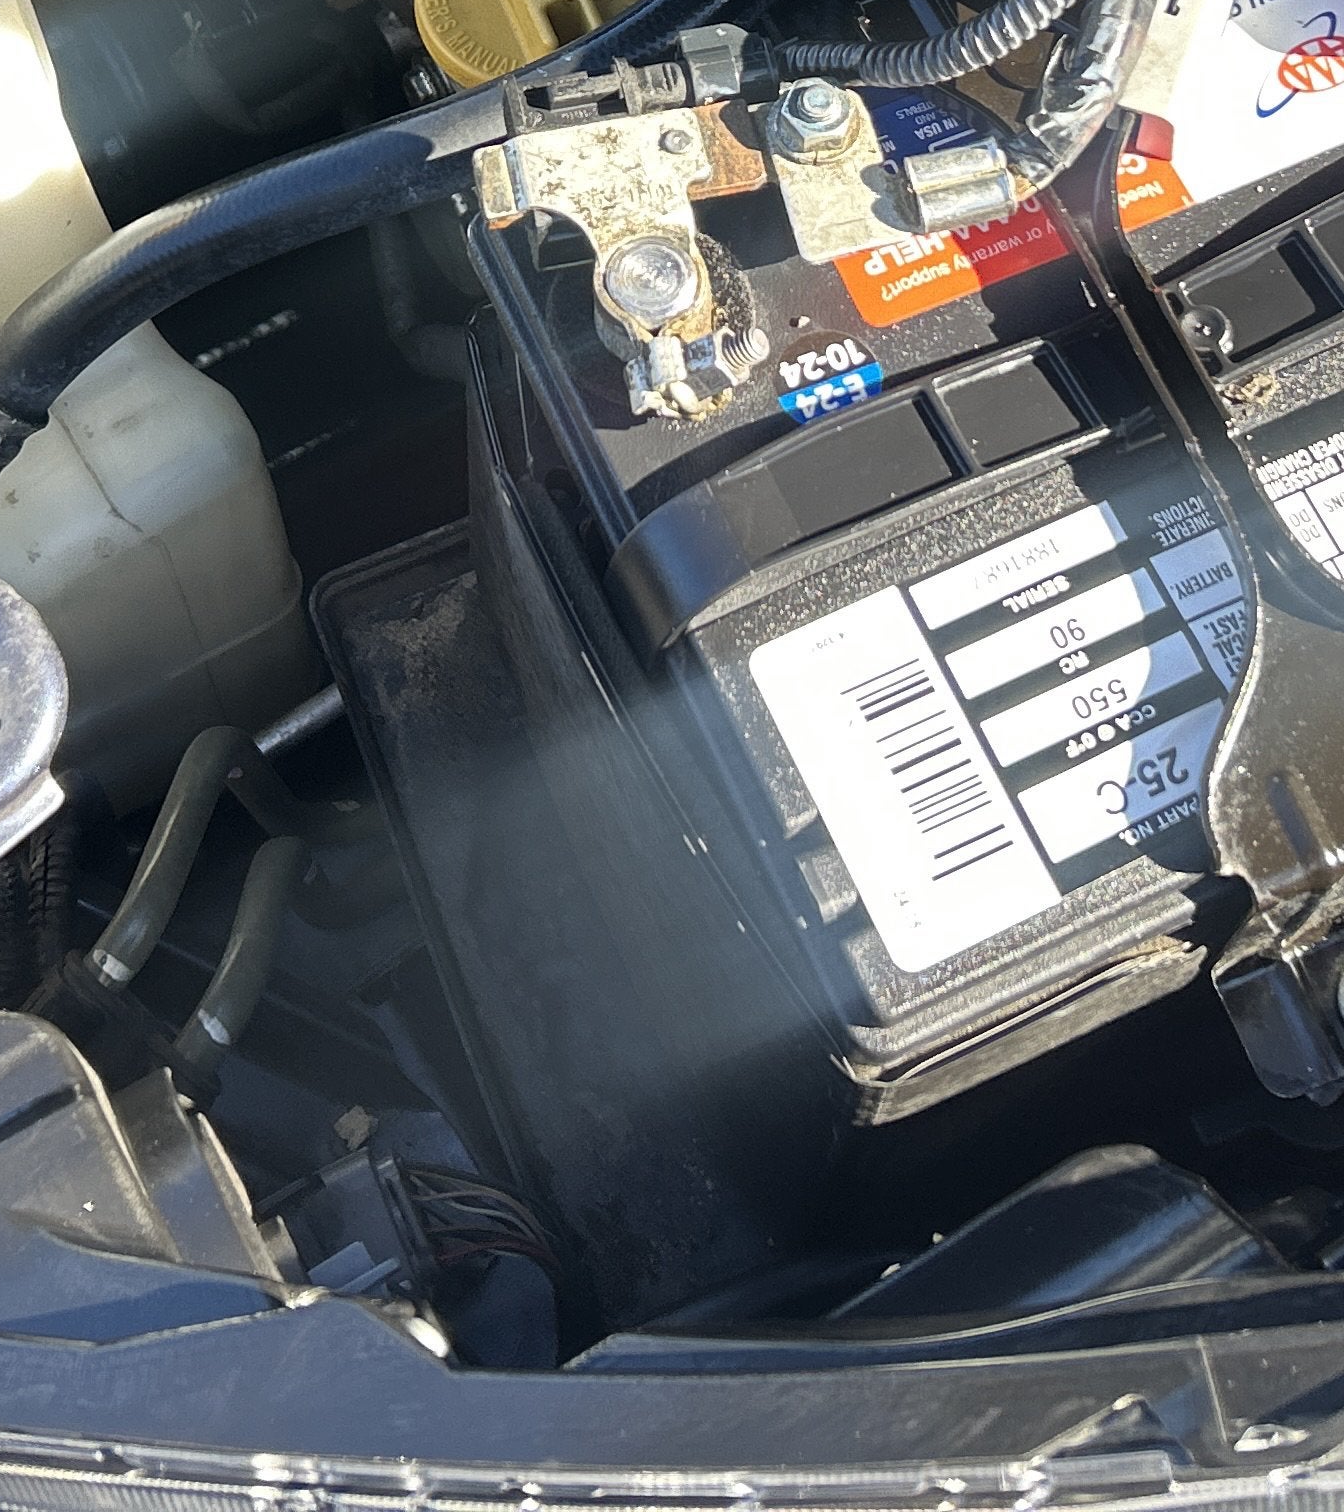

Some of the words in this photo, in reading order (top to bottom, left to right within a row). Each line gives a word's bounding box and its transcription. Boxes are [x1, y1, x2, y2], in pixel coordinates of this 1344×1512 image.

[913, 120, 942, 141] USA
[950, 229, 1023, 273] warranty
[1024, 225, 1043, 242] or
[877, 257, 952, 302] support?
[776, 332, 867, 392] 10-24
[1147, 494, 1205, 531] CTIONS.
[1150, 509, 1215, 549] INERATE.
[1001, 573, 1071, 615] SERIAL
[1169, 560, 1233, 600] BATTERY.
[1046, 615, 1087, 650] 90
[1069, 677, 1128, 720] 550
[1114, 702, 1157, 733] CCA
[1091, 744, 1192, 818] 25-C
[1150, 796, 1201, 830] PART
[1117, 820, 1153, 847] NO.
